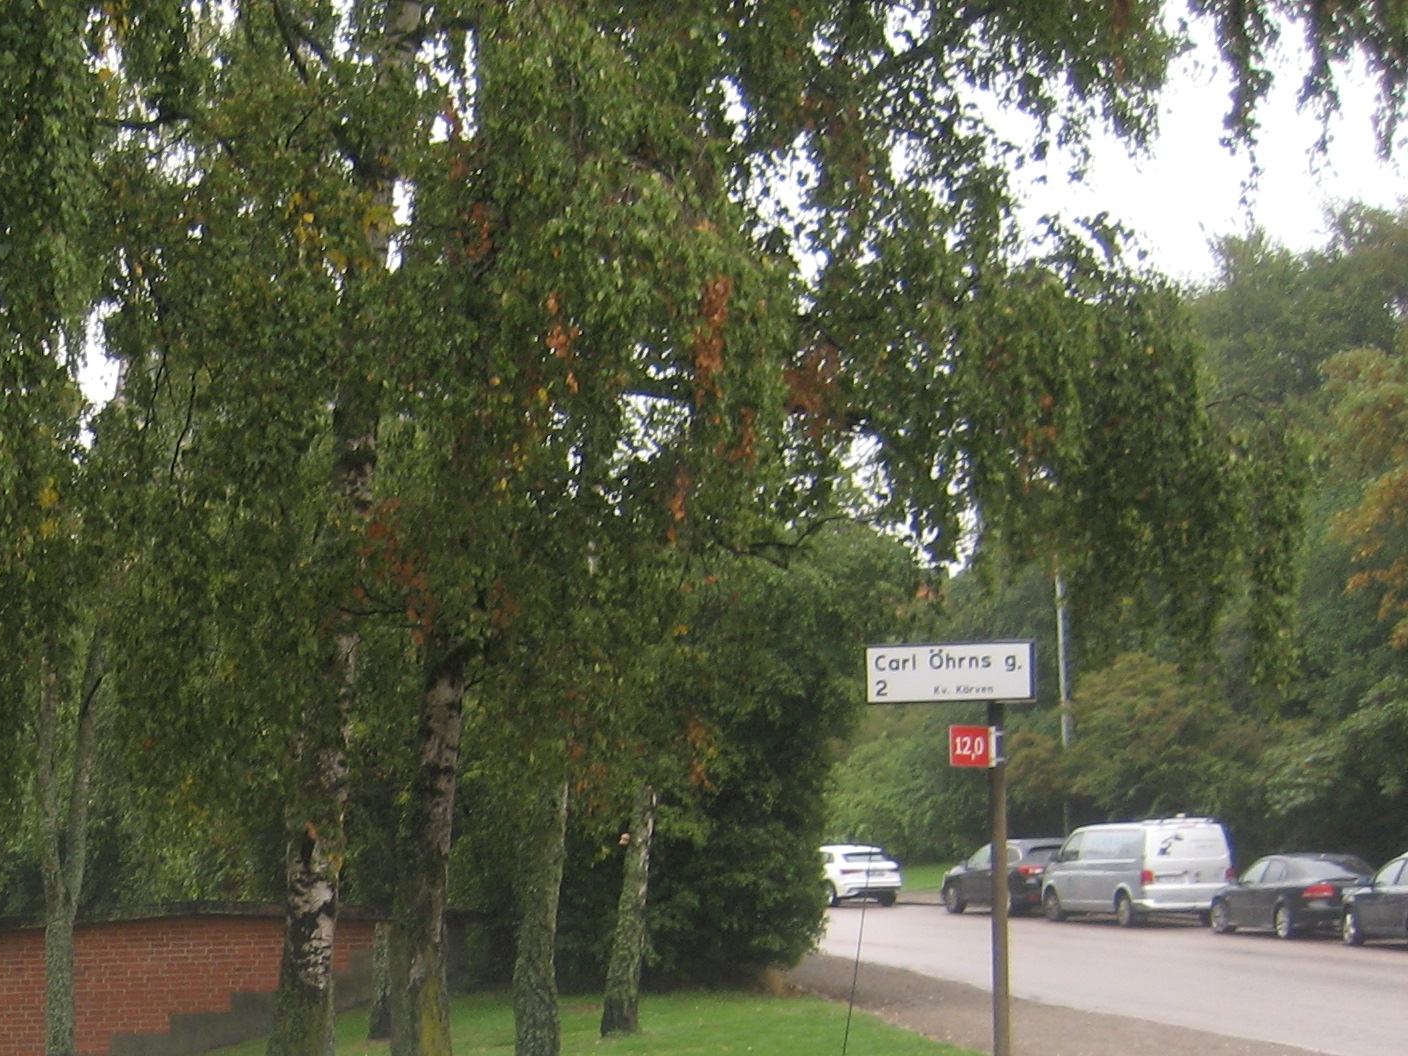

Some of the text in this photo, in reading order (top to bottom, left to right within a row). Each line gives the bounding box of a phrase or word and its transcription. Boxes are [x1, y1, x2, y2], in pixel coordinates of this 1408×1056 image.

[875, 649, 1022, 672] Carl Öhrns g.
[875, 680, 888, 697] 2
[954, 736, 984, 760] 12,0
